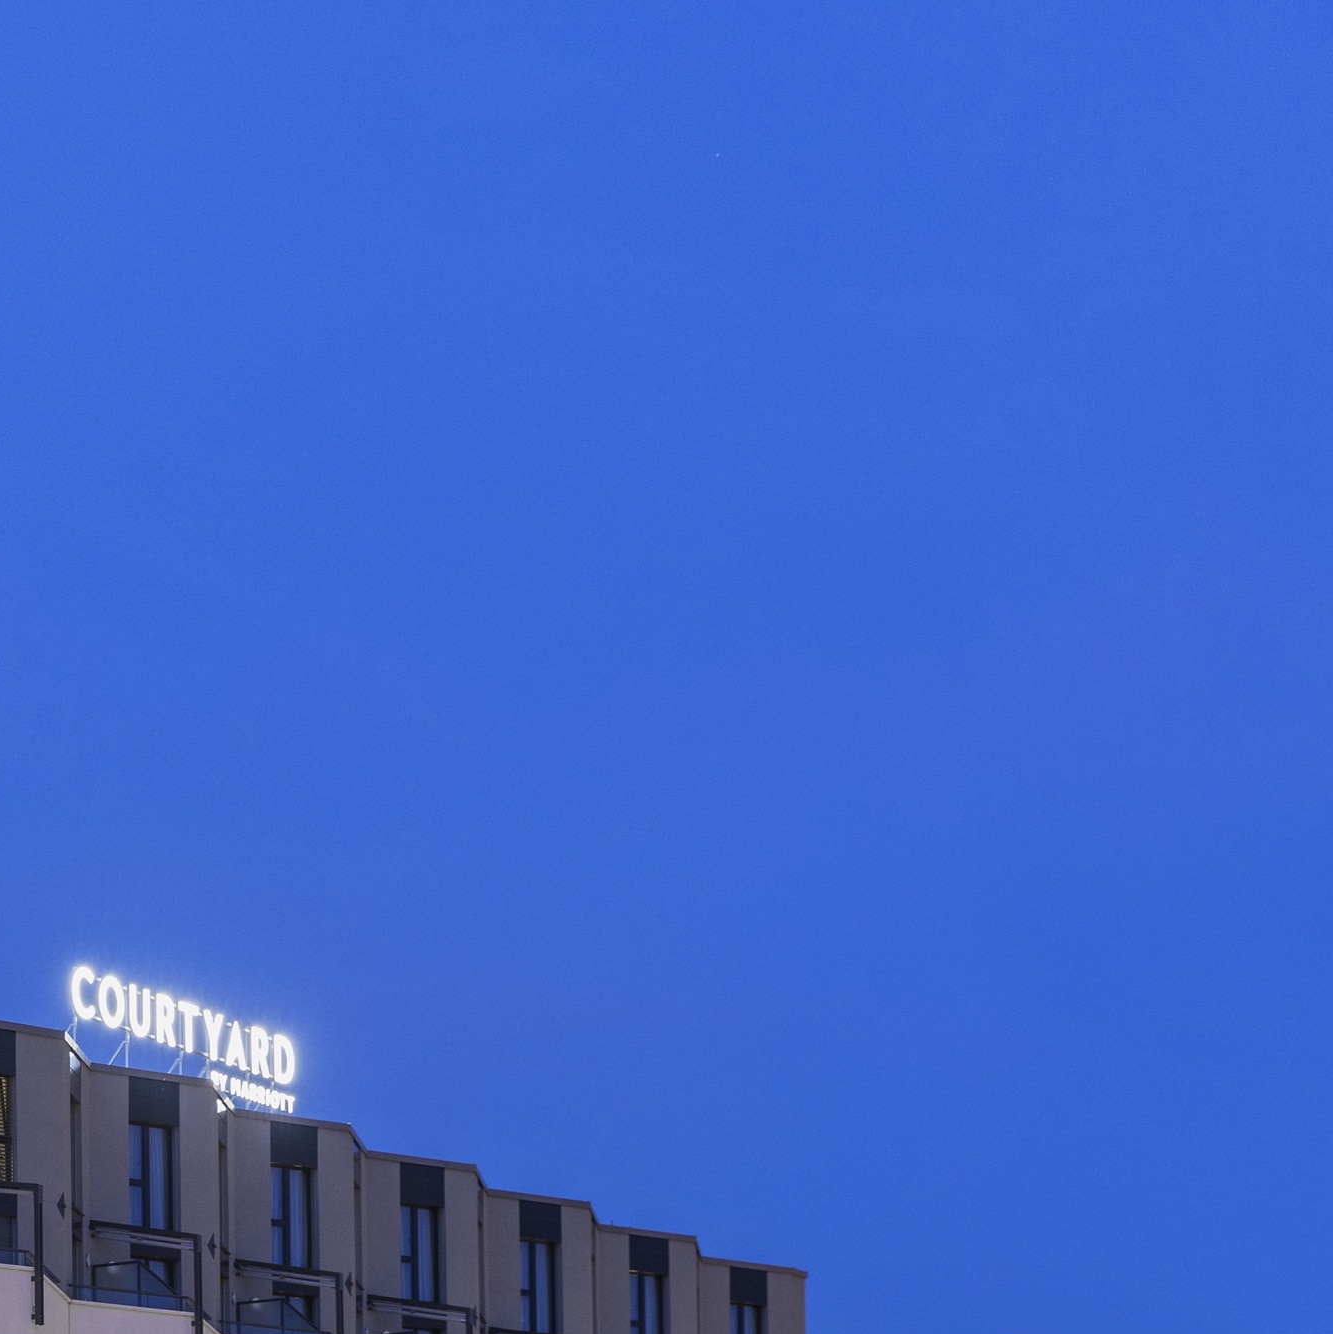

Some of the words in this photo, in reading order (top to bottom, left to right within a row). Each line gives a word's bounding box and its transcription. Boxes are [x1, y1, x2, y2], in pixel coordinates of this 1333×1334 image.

[71, 966, 295, 1085] COURTYARD
[211, 1071, 228, 1092] BY
[230, 1077, 295, 1114] MARRIOTT
